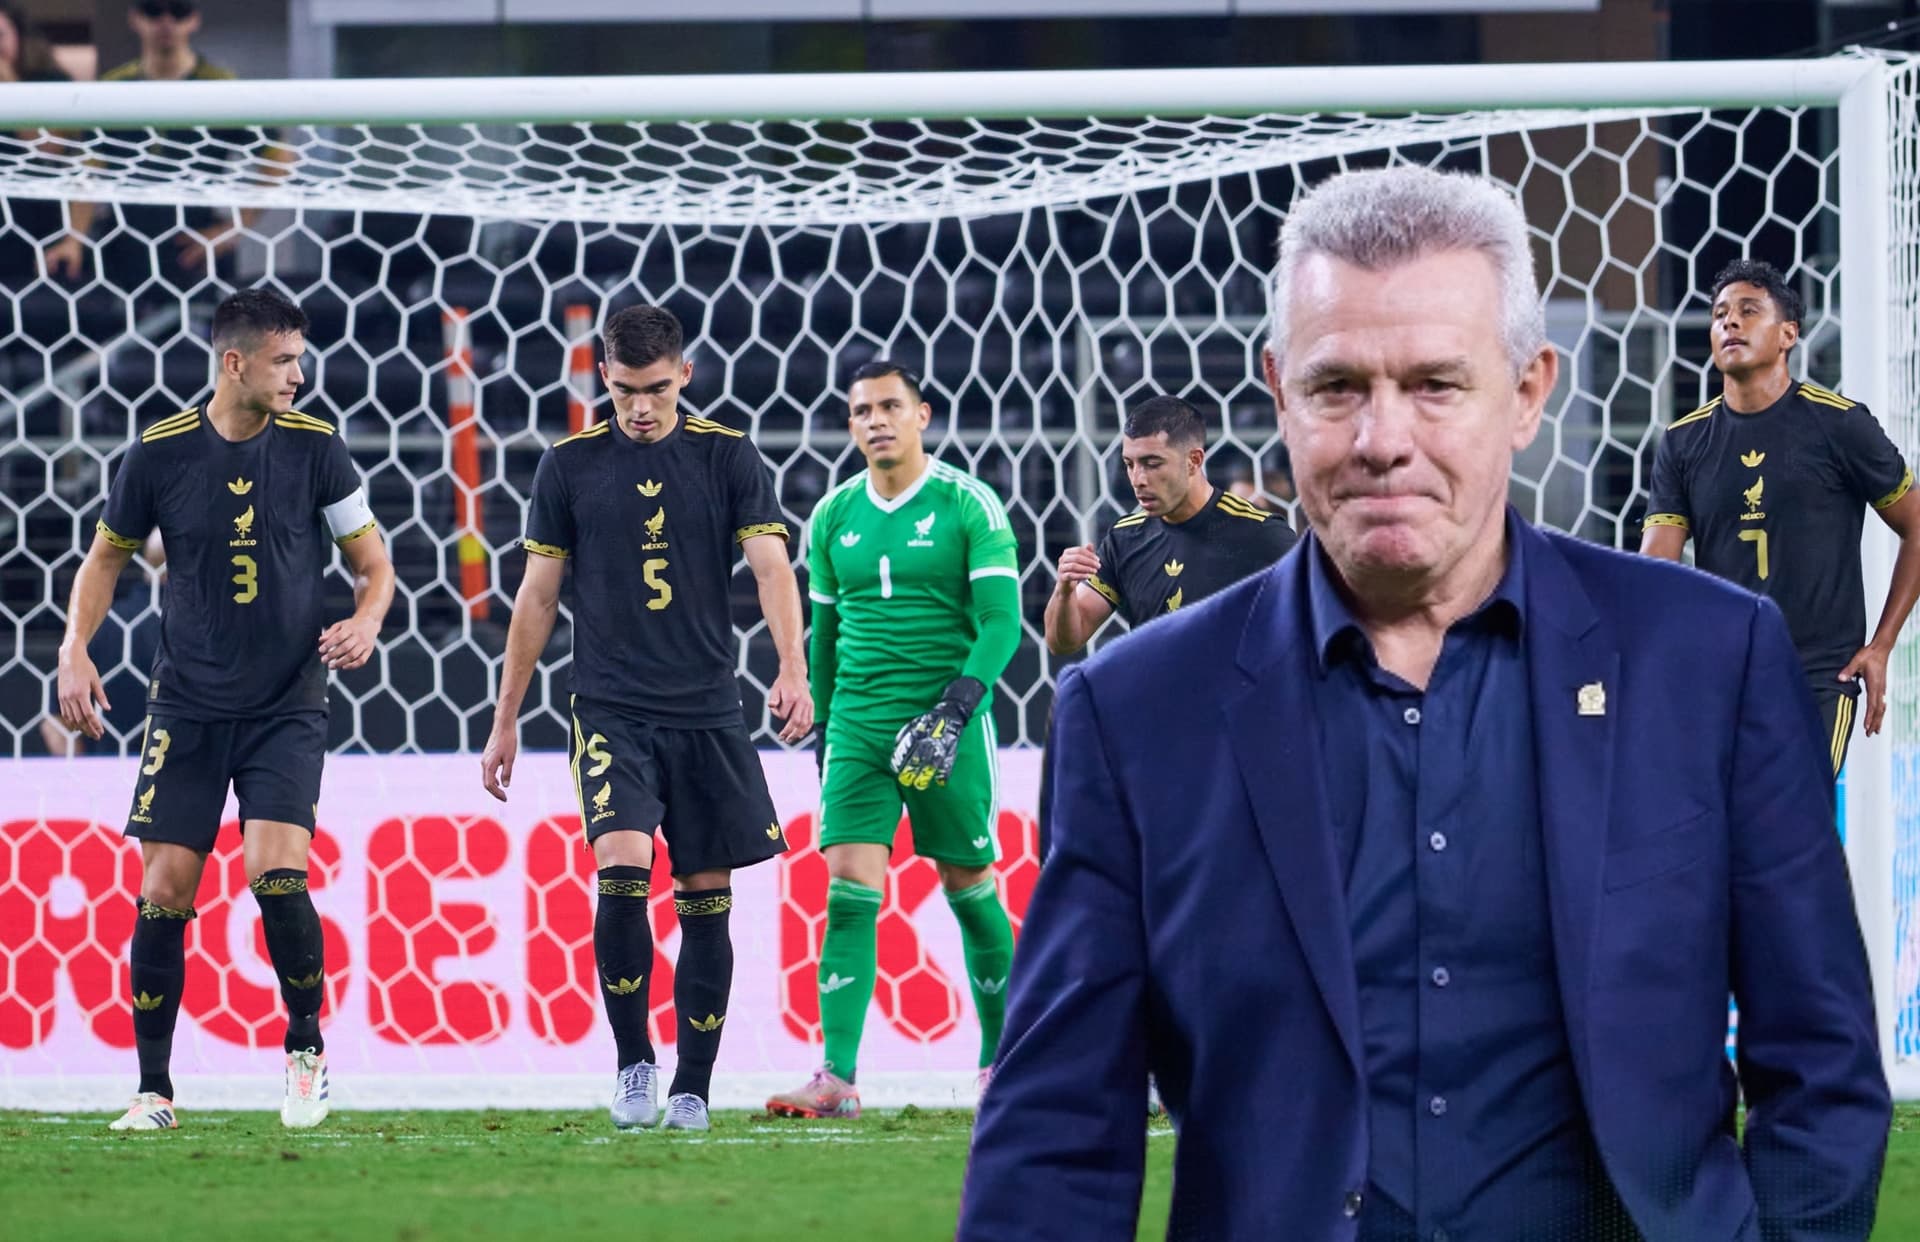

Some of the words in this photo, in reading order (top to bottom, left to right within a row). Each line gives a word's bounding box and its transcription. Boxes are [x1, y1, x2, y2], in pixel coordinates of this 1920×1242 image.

[879, 554, 892, 599] 1
[1737, 529, 1769, 581] 7
[231, 555, 258, 604] 3
[643, 558, 672, 610] 5
[142, 728, 171, 776] 3
[586, 733, 613, 778] 5
